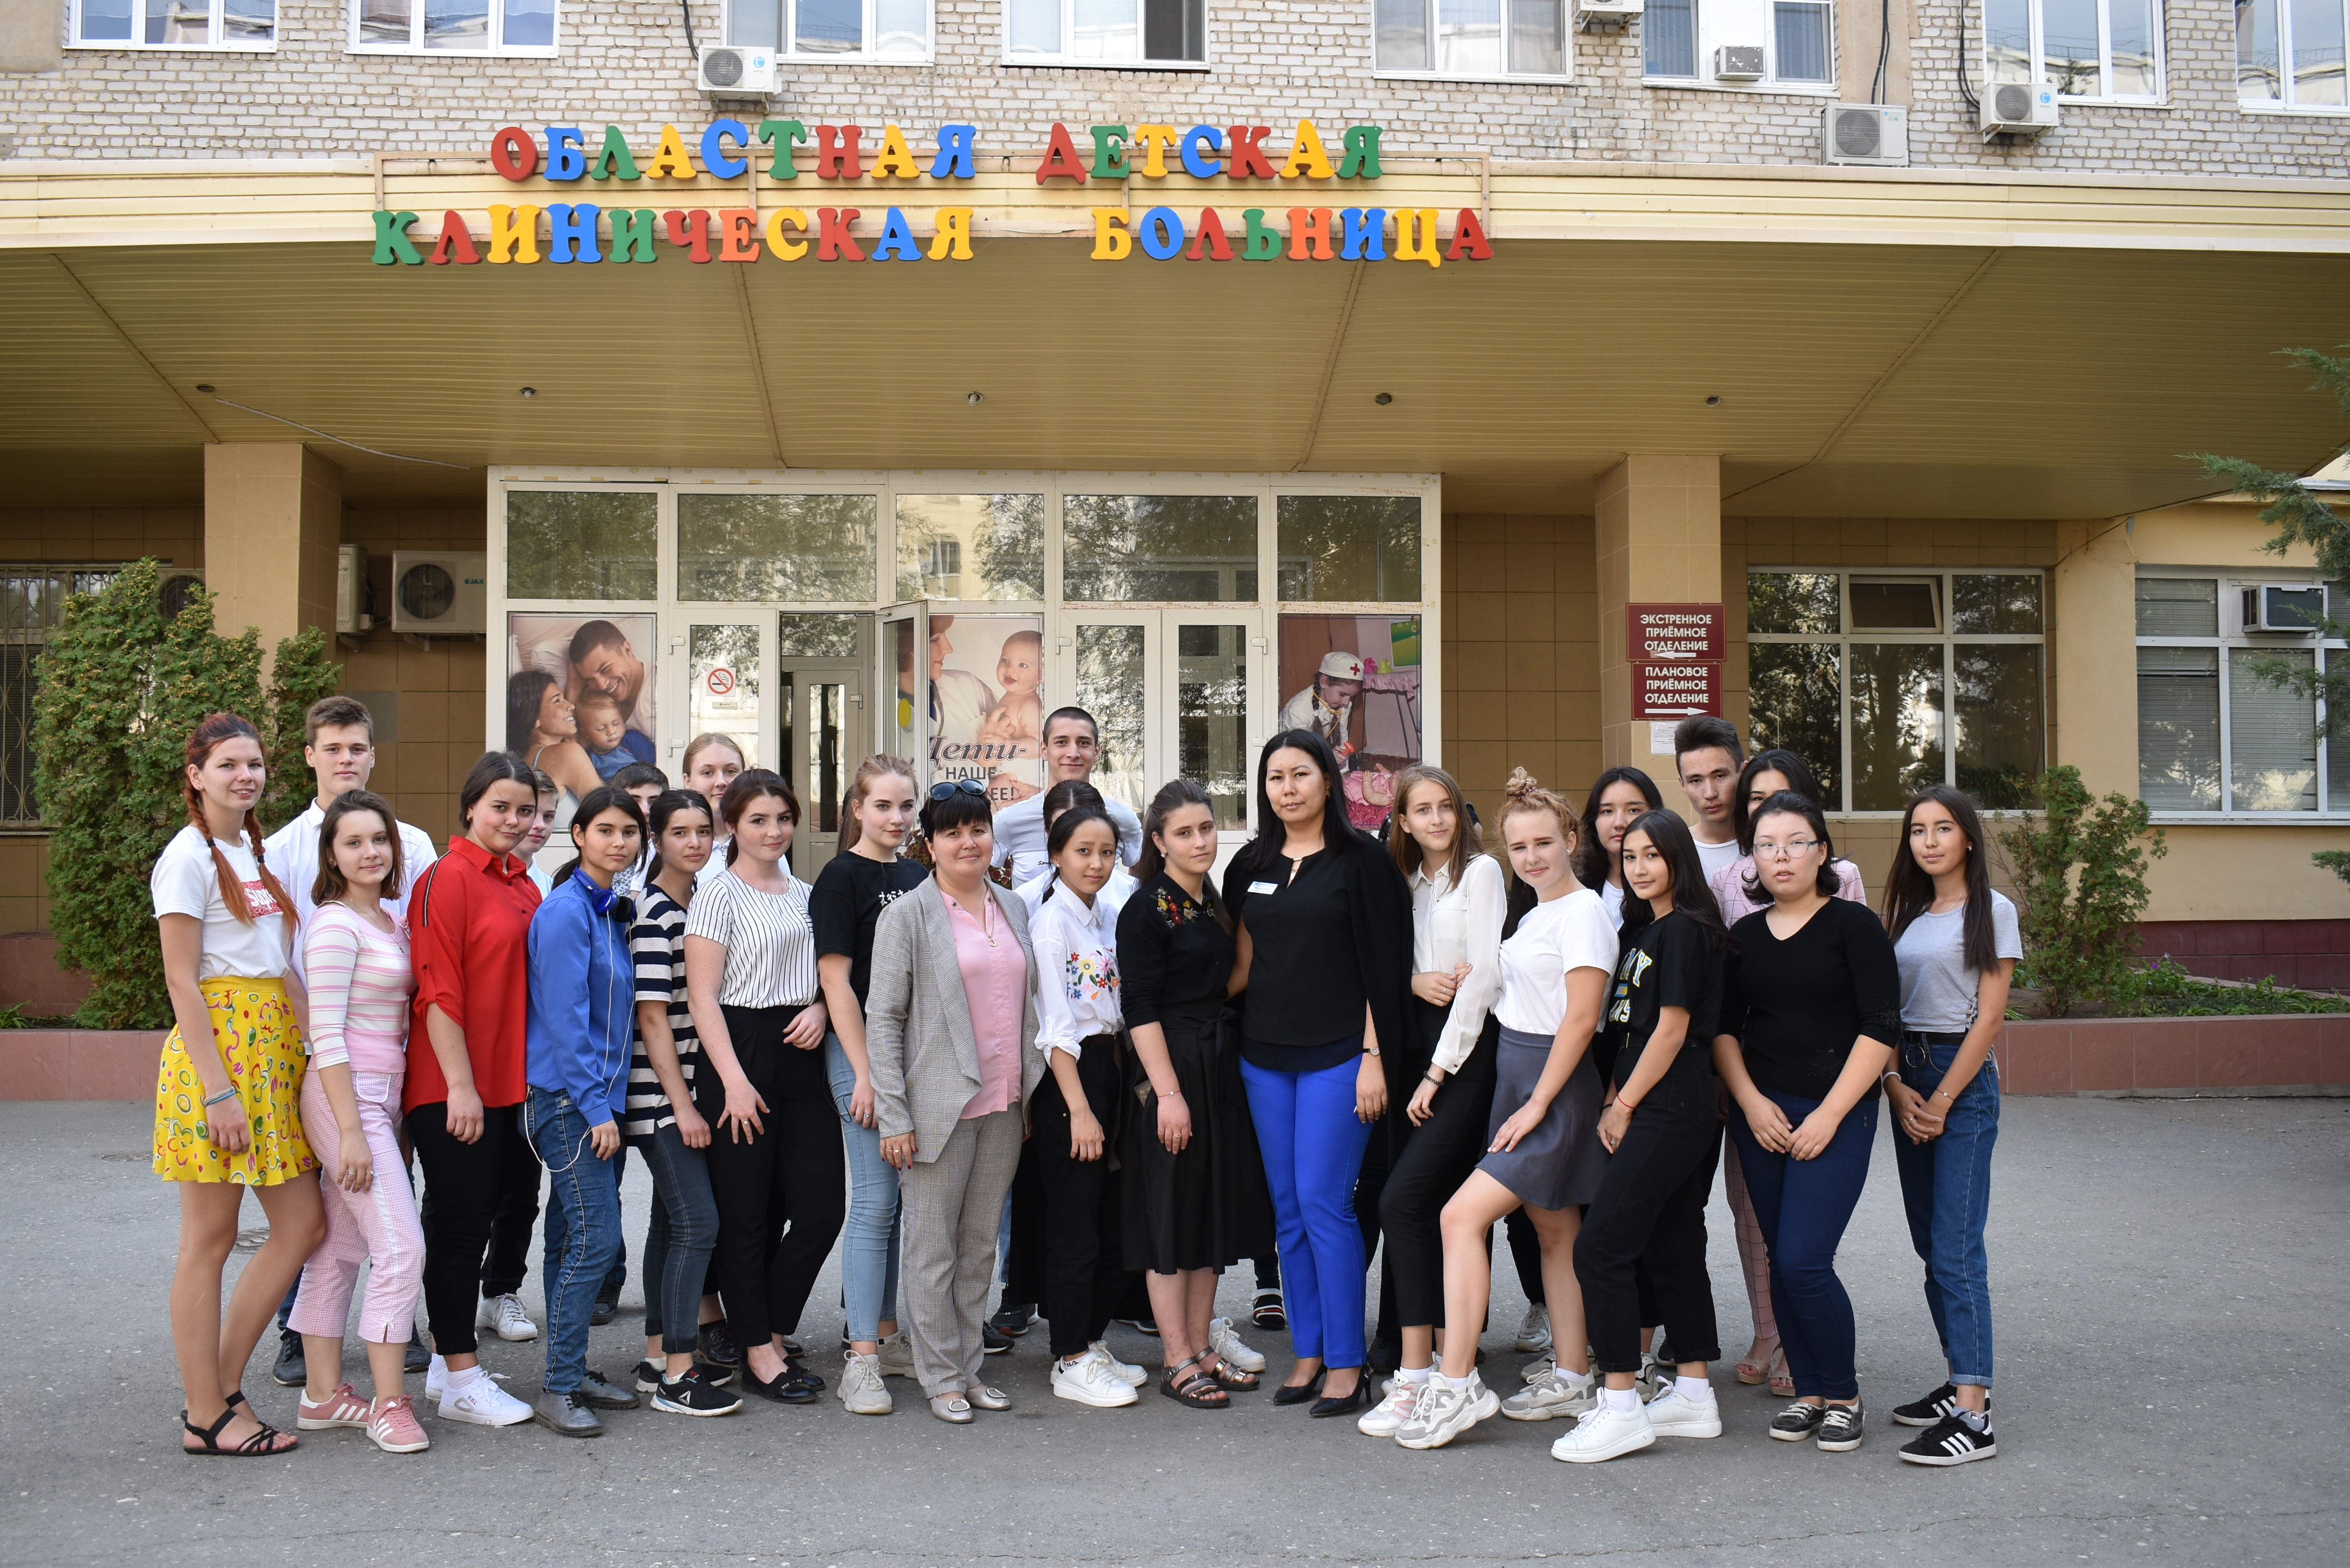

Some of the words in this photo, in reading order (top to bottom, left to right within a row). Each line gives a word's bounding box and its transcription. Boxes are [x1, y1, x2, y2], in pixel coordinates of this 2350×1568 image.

[490, 118, 976, 182] ОБЛАСТНАЯ
[1036, 119, 1383, 185] ДЕТСКАЯ
[371, 203, 974, 265] КЛИНИЧЕСКАЯ
[1090, 206, 1494, 269] БОЛЬНИЦА
[1640, 614, 1712, 624] ЭКСТРЕННОЕ
[1646, 626, 1707, 637] ПРИЁМНОЕ
[1644, 641, 1708, 651] ОТДЕЛЕНИЕ
[1645, 667, 1708, 676] ПЛАНОВОЕ
[1646, 678, 1707, 690] ПРИЁМНОЕ
[1645, 693, 1709, 704] ОТДЕЛЕНИЕ
[946, 766, 997, 780] НАШЕ
